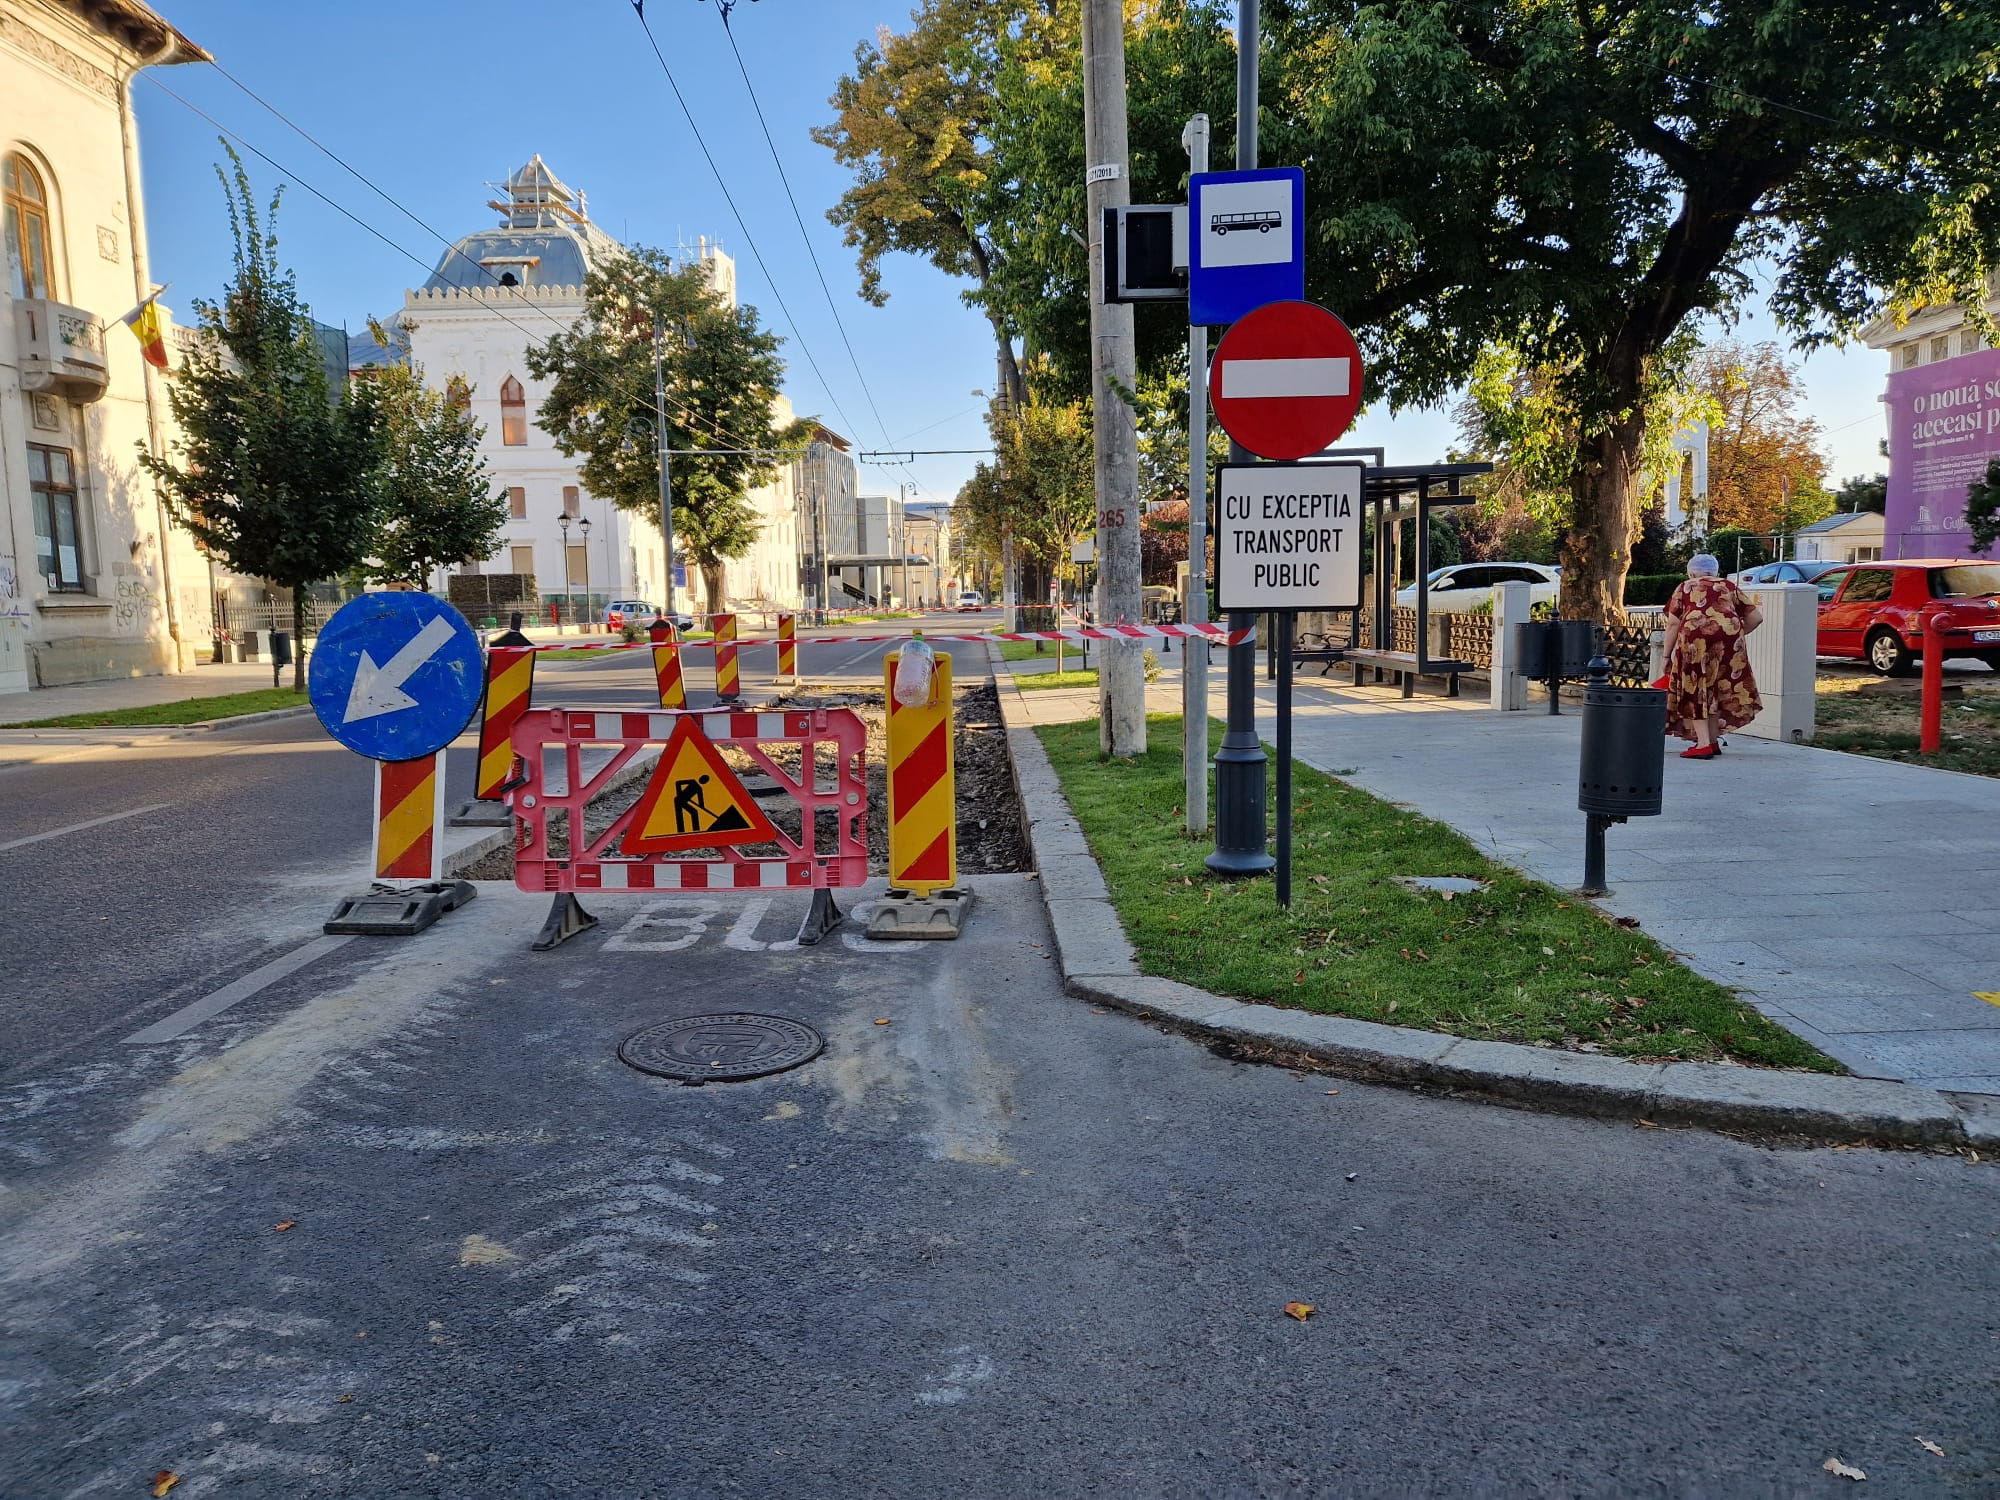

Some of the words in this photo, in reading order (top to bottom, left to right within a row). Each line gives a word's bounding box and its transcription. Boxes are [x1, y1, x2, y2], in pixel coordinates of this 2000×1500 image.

[1913, 396, 1925, 414] o
[1930, 377, 1980, 411] nouă
[1099, 508, 1125, 528] 265
[1226, 495, 1251, 520] CU
[1262, 493, 1351, 519] EXCEPTIA
[1232, 528, 1343, 554] TRANSPORT
[1254, 562, 1320, 588] PUBLIC
